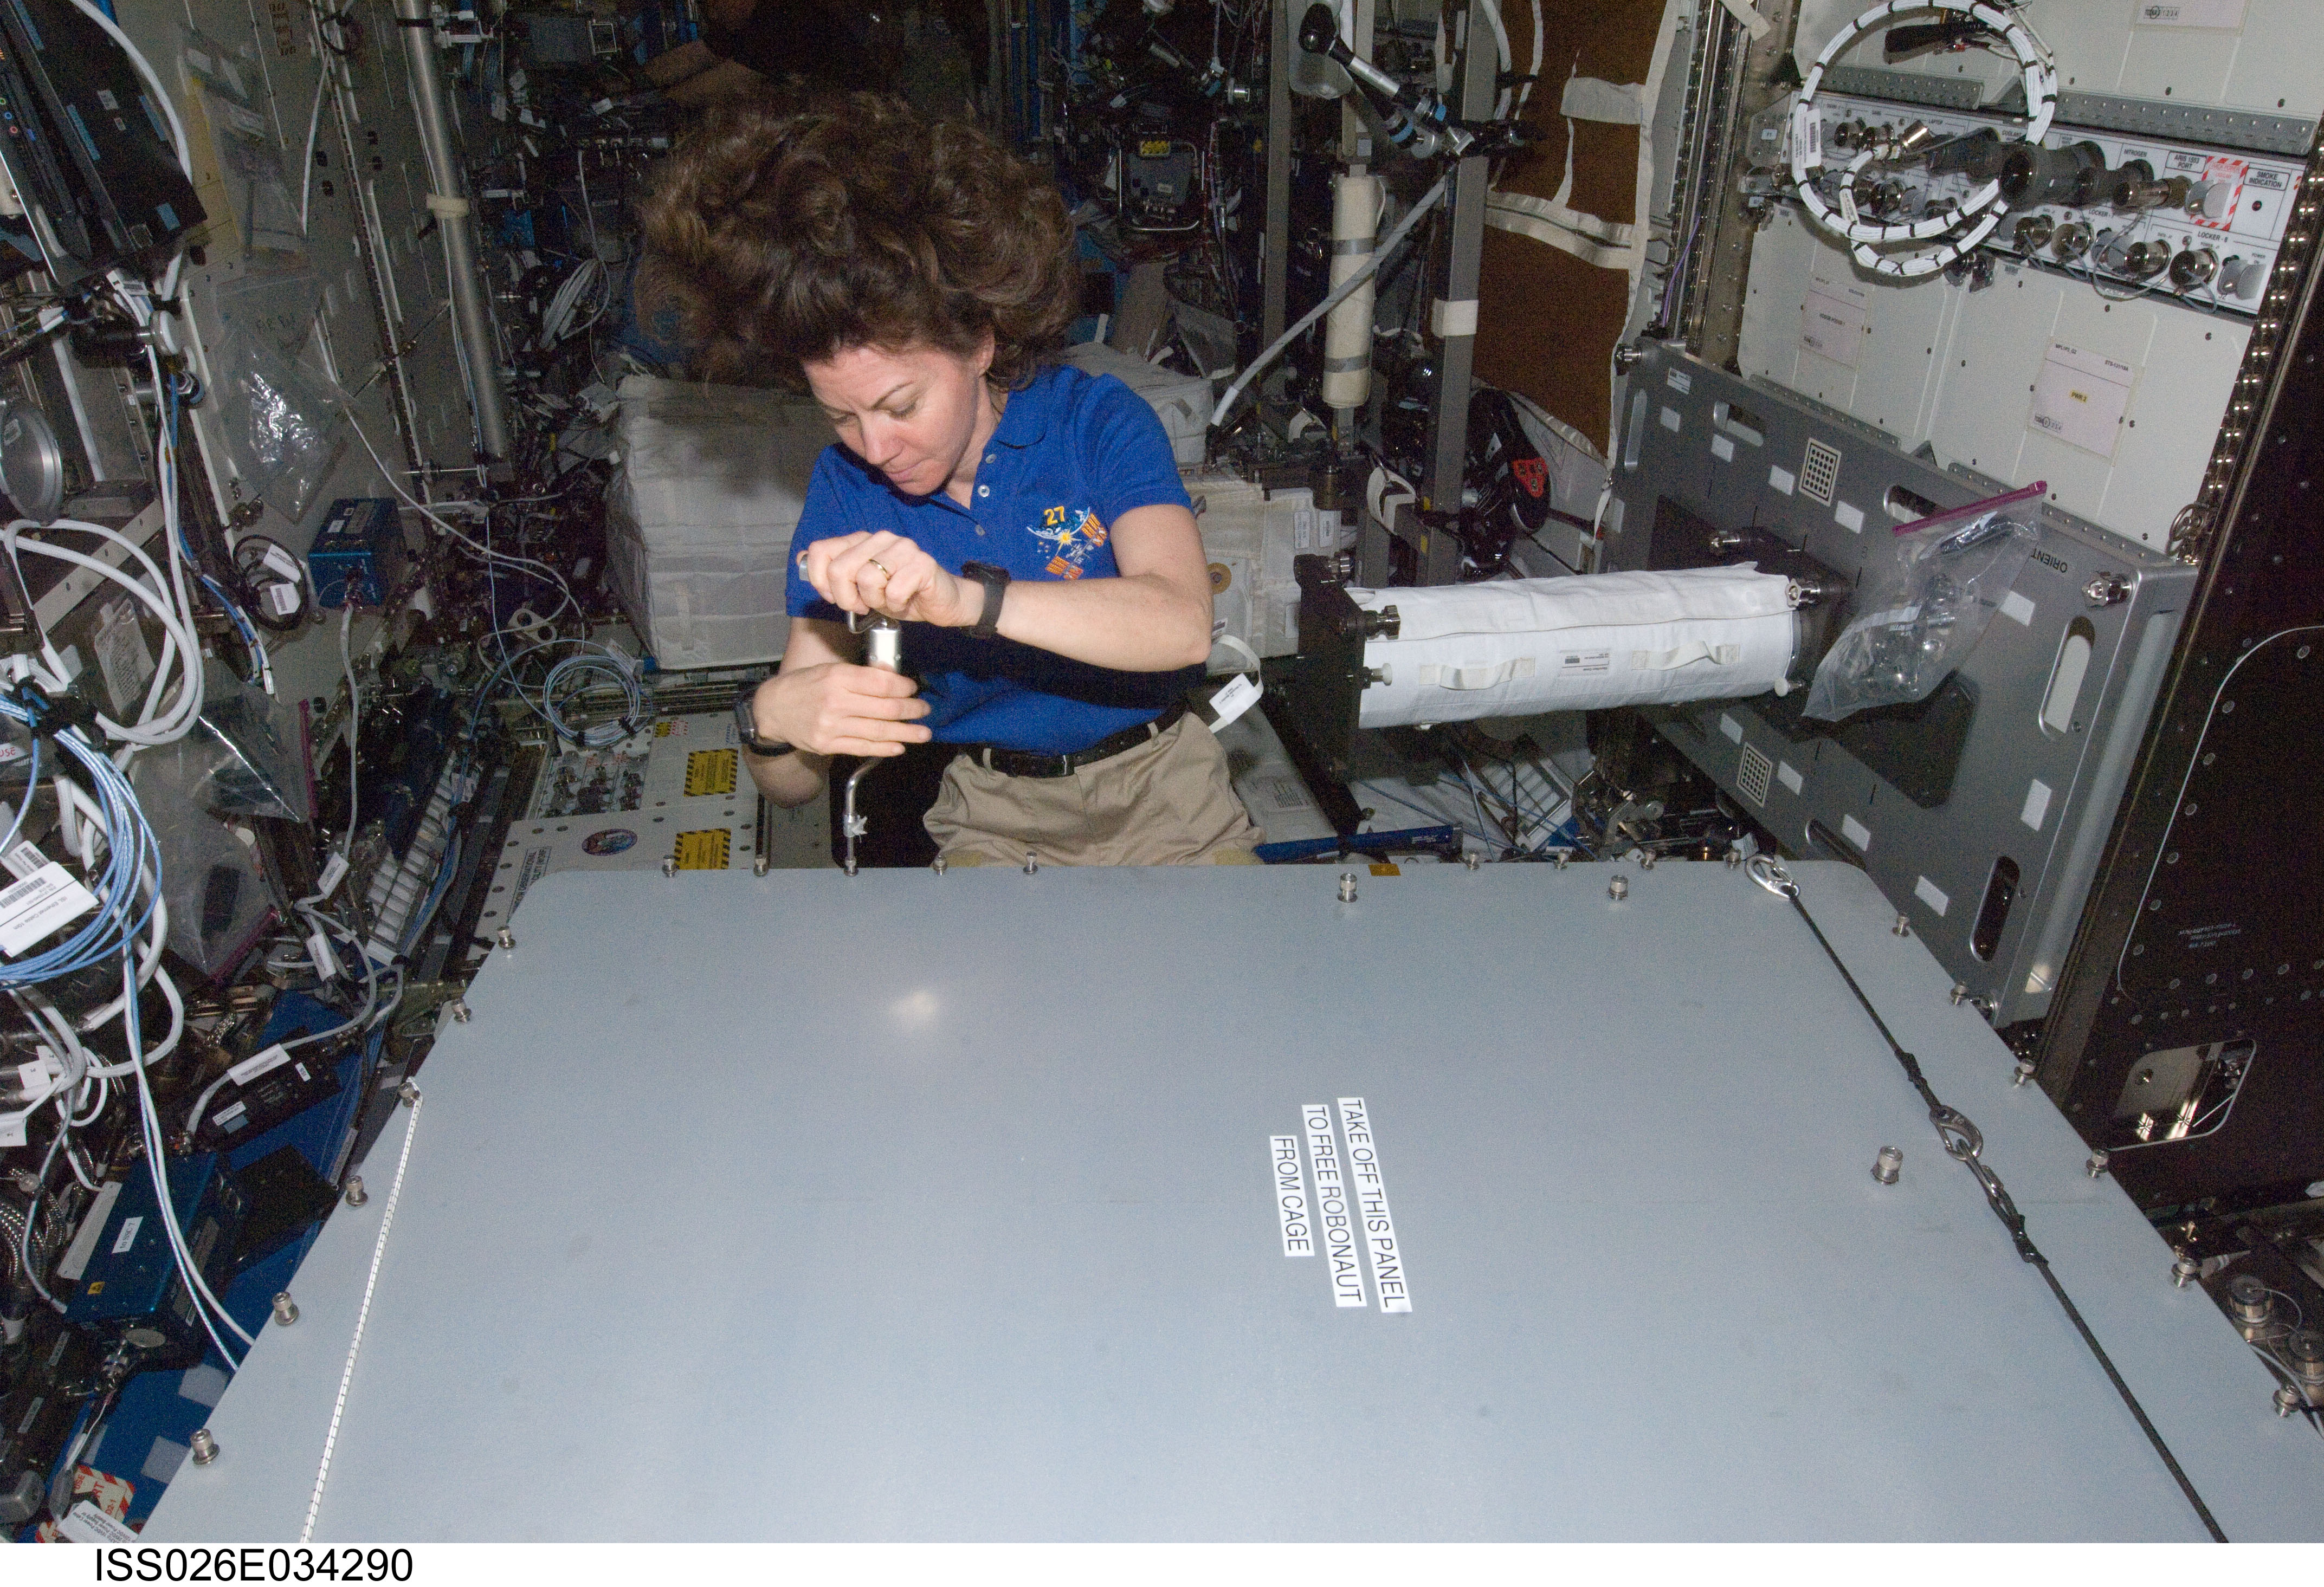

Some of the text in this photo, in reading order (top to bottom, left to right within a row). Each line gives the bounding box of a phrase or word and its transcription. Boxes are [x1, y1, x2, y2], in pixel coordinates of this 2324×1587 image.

[2124, 149, 2147, 157] NITROGEN
[2257, 171, 2277, 180] SMOKE
[2249, 177, 2282, 188] INDICATION
[2198, 231, 2220, 241] LOCKER
[2071, 391, 2083, 400] PWR
[1044, 506, 1065, 526] 27
[2031, 548, 2068, 573] ORIENT
[38, 902, 59, 915] Ethernet
[25, 913, 40, 923] Cable
[1274, 1138, 1309, 1251] FROM CAGE
[1307, 1107, 1362, 1301] TO FREE ROBONAUT
[1342, 1099, 1405, 1307] TAKE OFF THIS PANEL
[74, 1474, 85, 1490] USE
[87, 1514, 98, 1523] Supply
[94, 1514, 105, 1523] Supply
